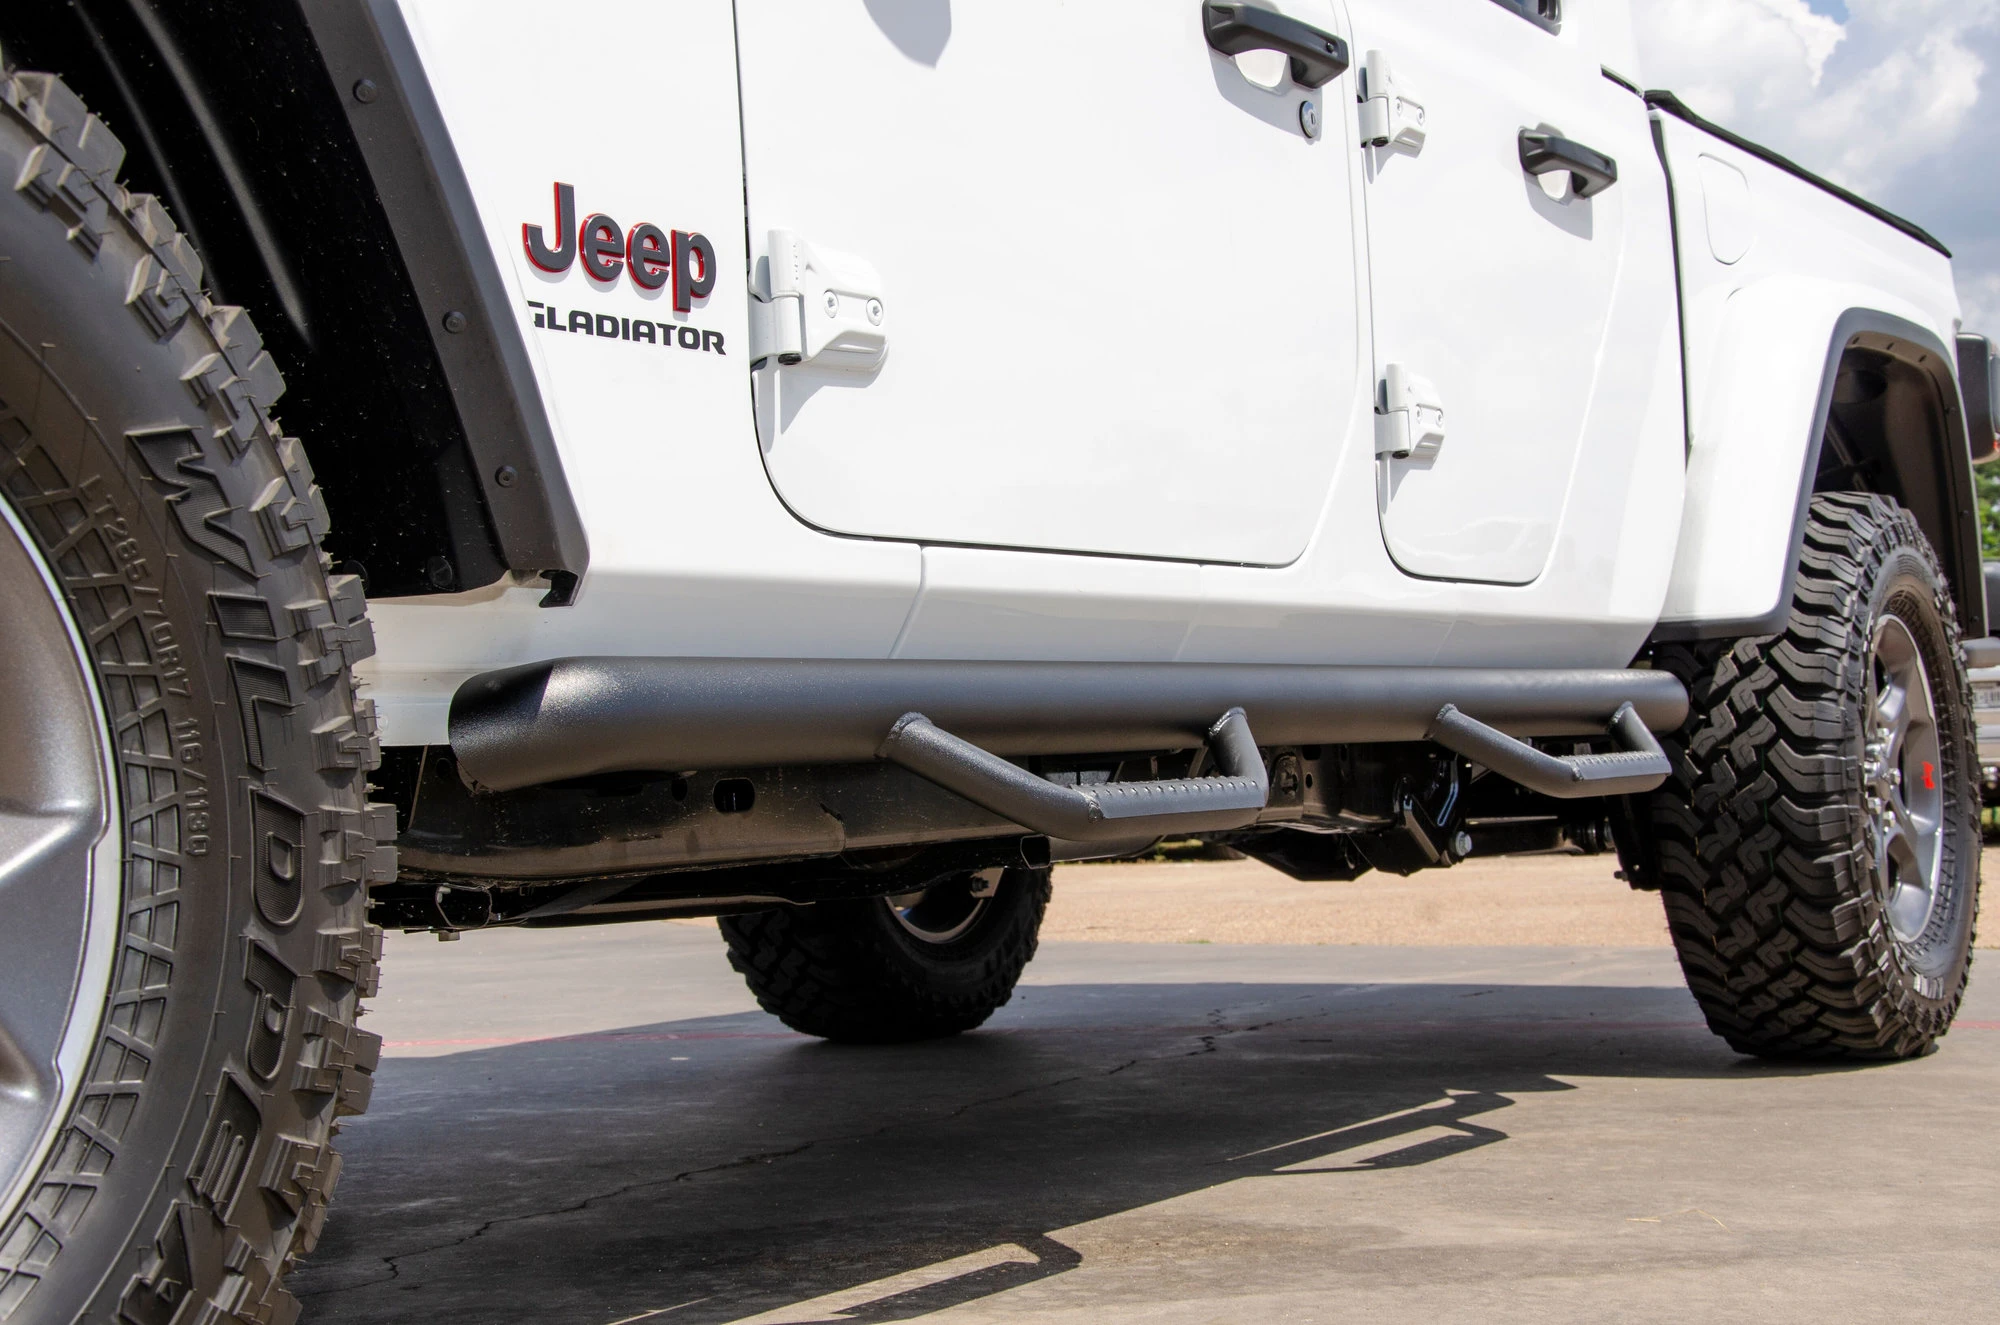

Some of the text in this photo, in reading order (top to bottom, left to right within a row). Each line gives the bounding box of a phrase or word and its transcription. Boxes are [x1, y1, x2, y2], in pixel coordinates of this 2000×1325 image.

[522, 181, 717, 313] Jeep
[79, 474, 213, 857] LT285/70R17 116/113Q
